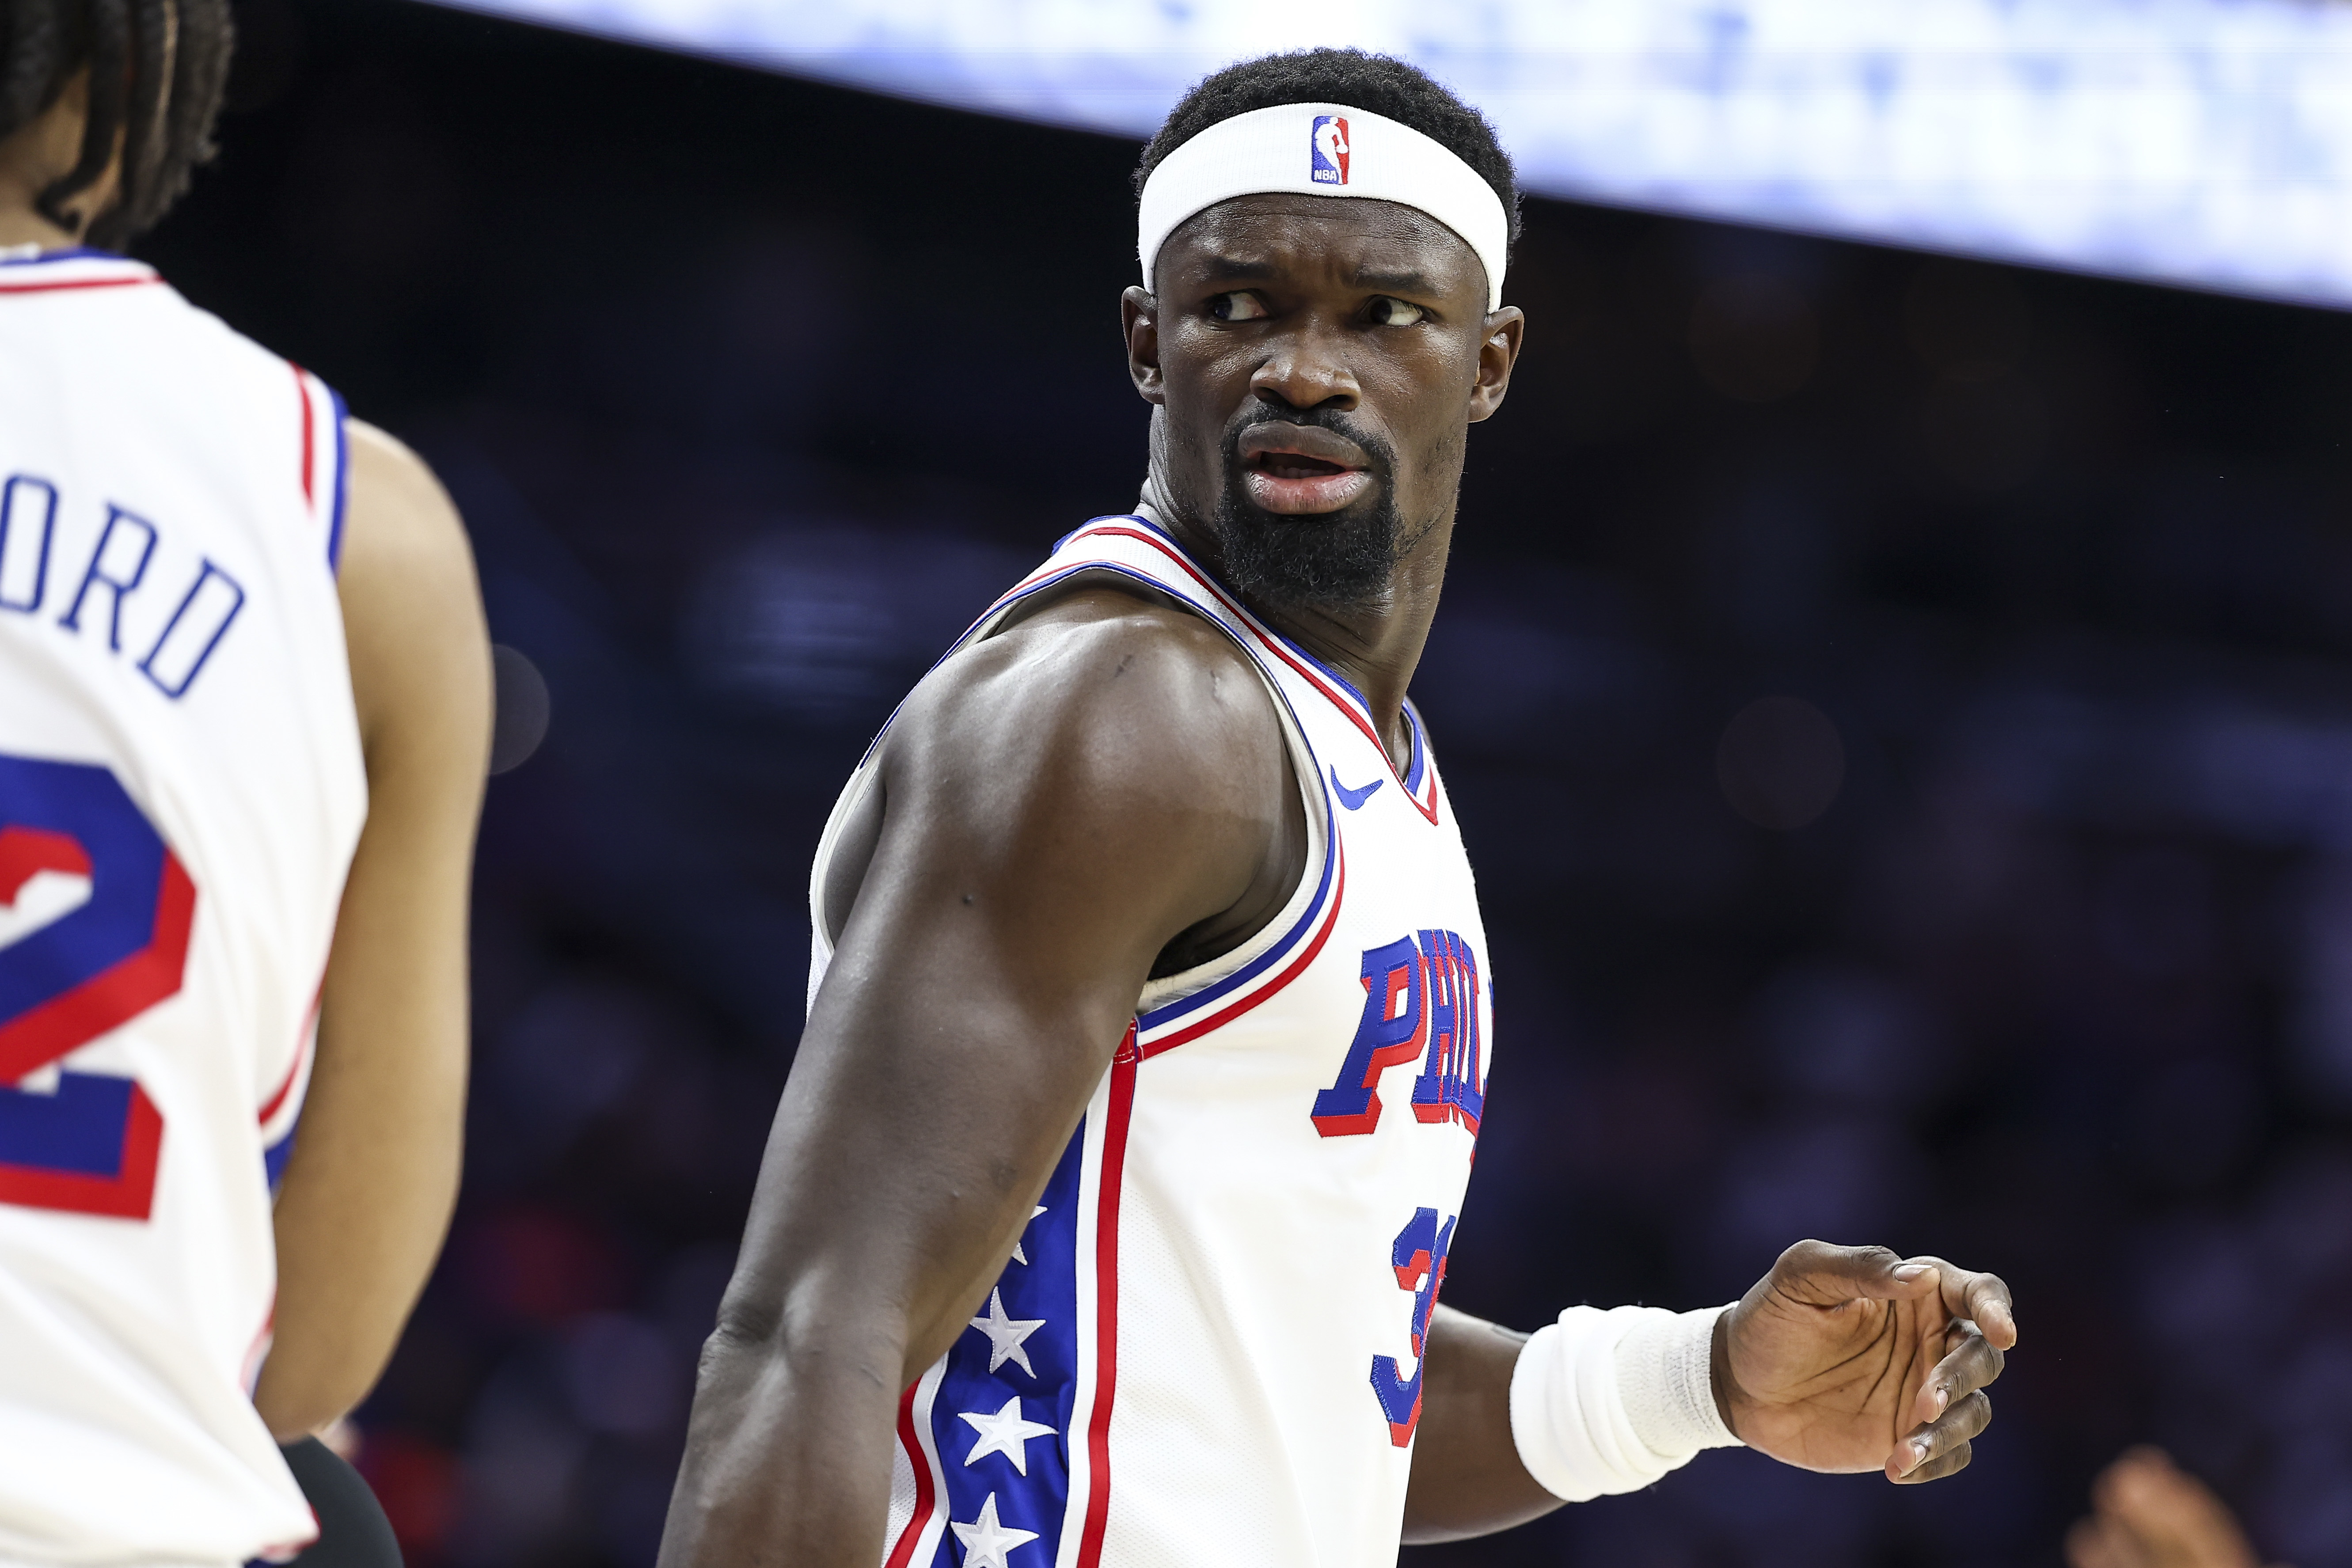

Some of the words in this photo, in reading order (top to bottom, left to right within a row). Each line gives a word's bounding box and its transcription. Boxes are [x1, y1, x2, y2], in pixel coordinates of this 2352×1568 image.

[1314, 169, 1337, 181] NBA
[0, 474, 246, 699] ORD
[0, 754, 198, 1223] 2
[1311, 929, 1494, 1140] PHIL
